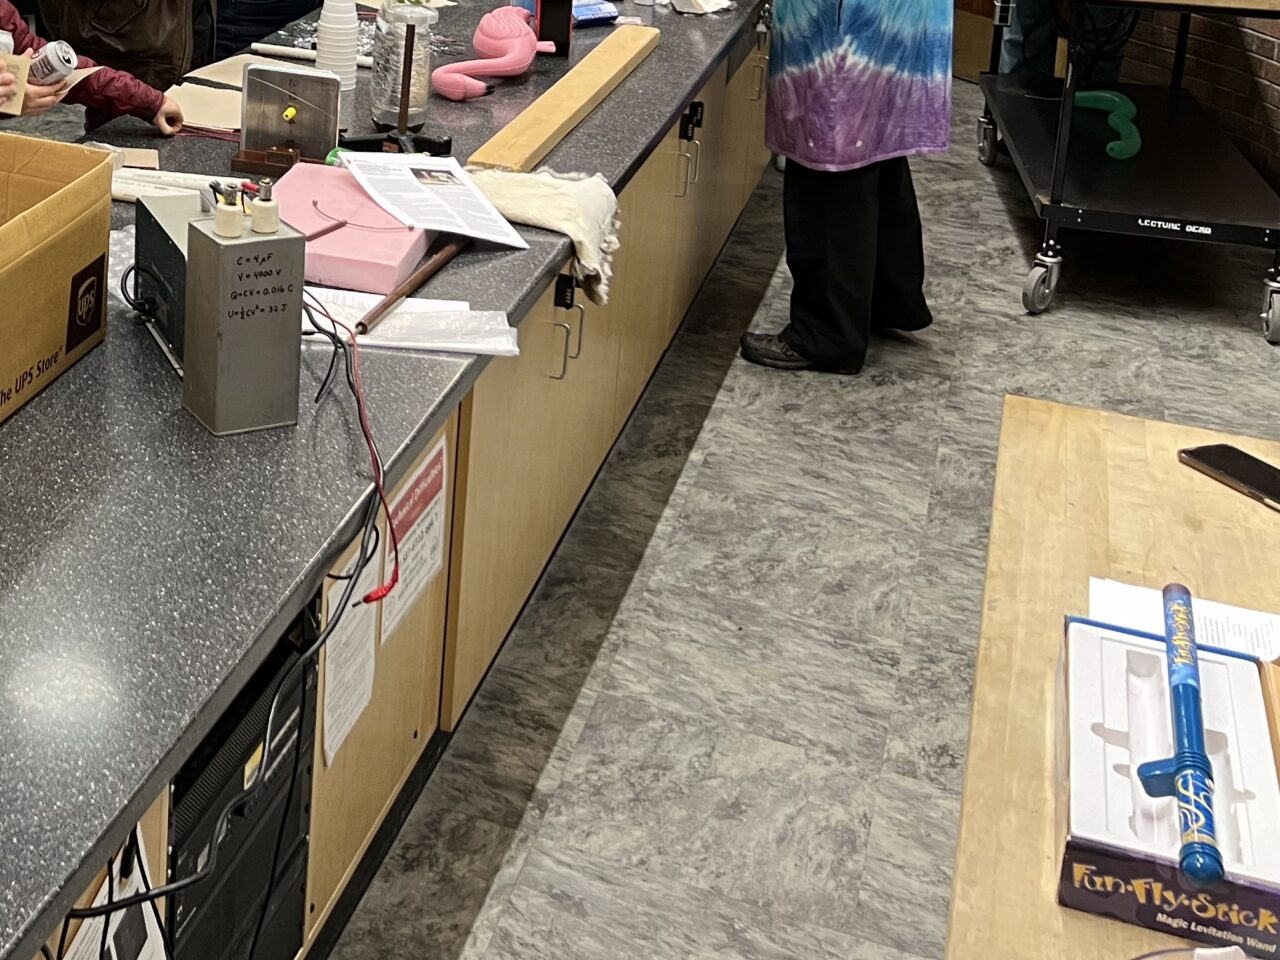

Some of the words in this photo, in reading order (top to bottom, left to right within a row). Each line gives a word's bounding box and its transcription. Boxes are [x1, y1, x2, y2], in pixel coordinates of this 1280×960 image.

[1138, 218, 1181, 231] LECTURE
[1185, 224, 1212, 234] DEMO
[237, 256, 243, 266] C
[238, 272, 243, 281] V
[253, 269, 273, 279] 4000
[275, 268, 282, 276] V
[287, 284, 294, 292] C
[15, 366, 34, 394] UPS
[1156, 912, 1189, 930] Magic
[1190, 921, 1244, 945] Levitation
[1246, 937, 1277, 953] Wand
